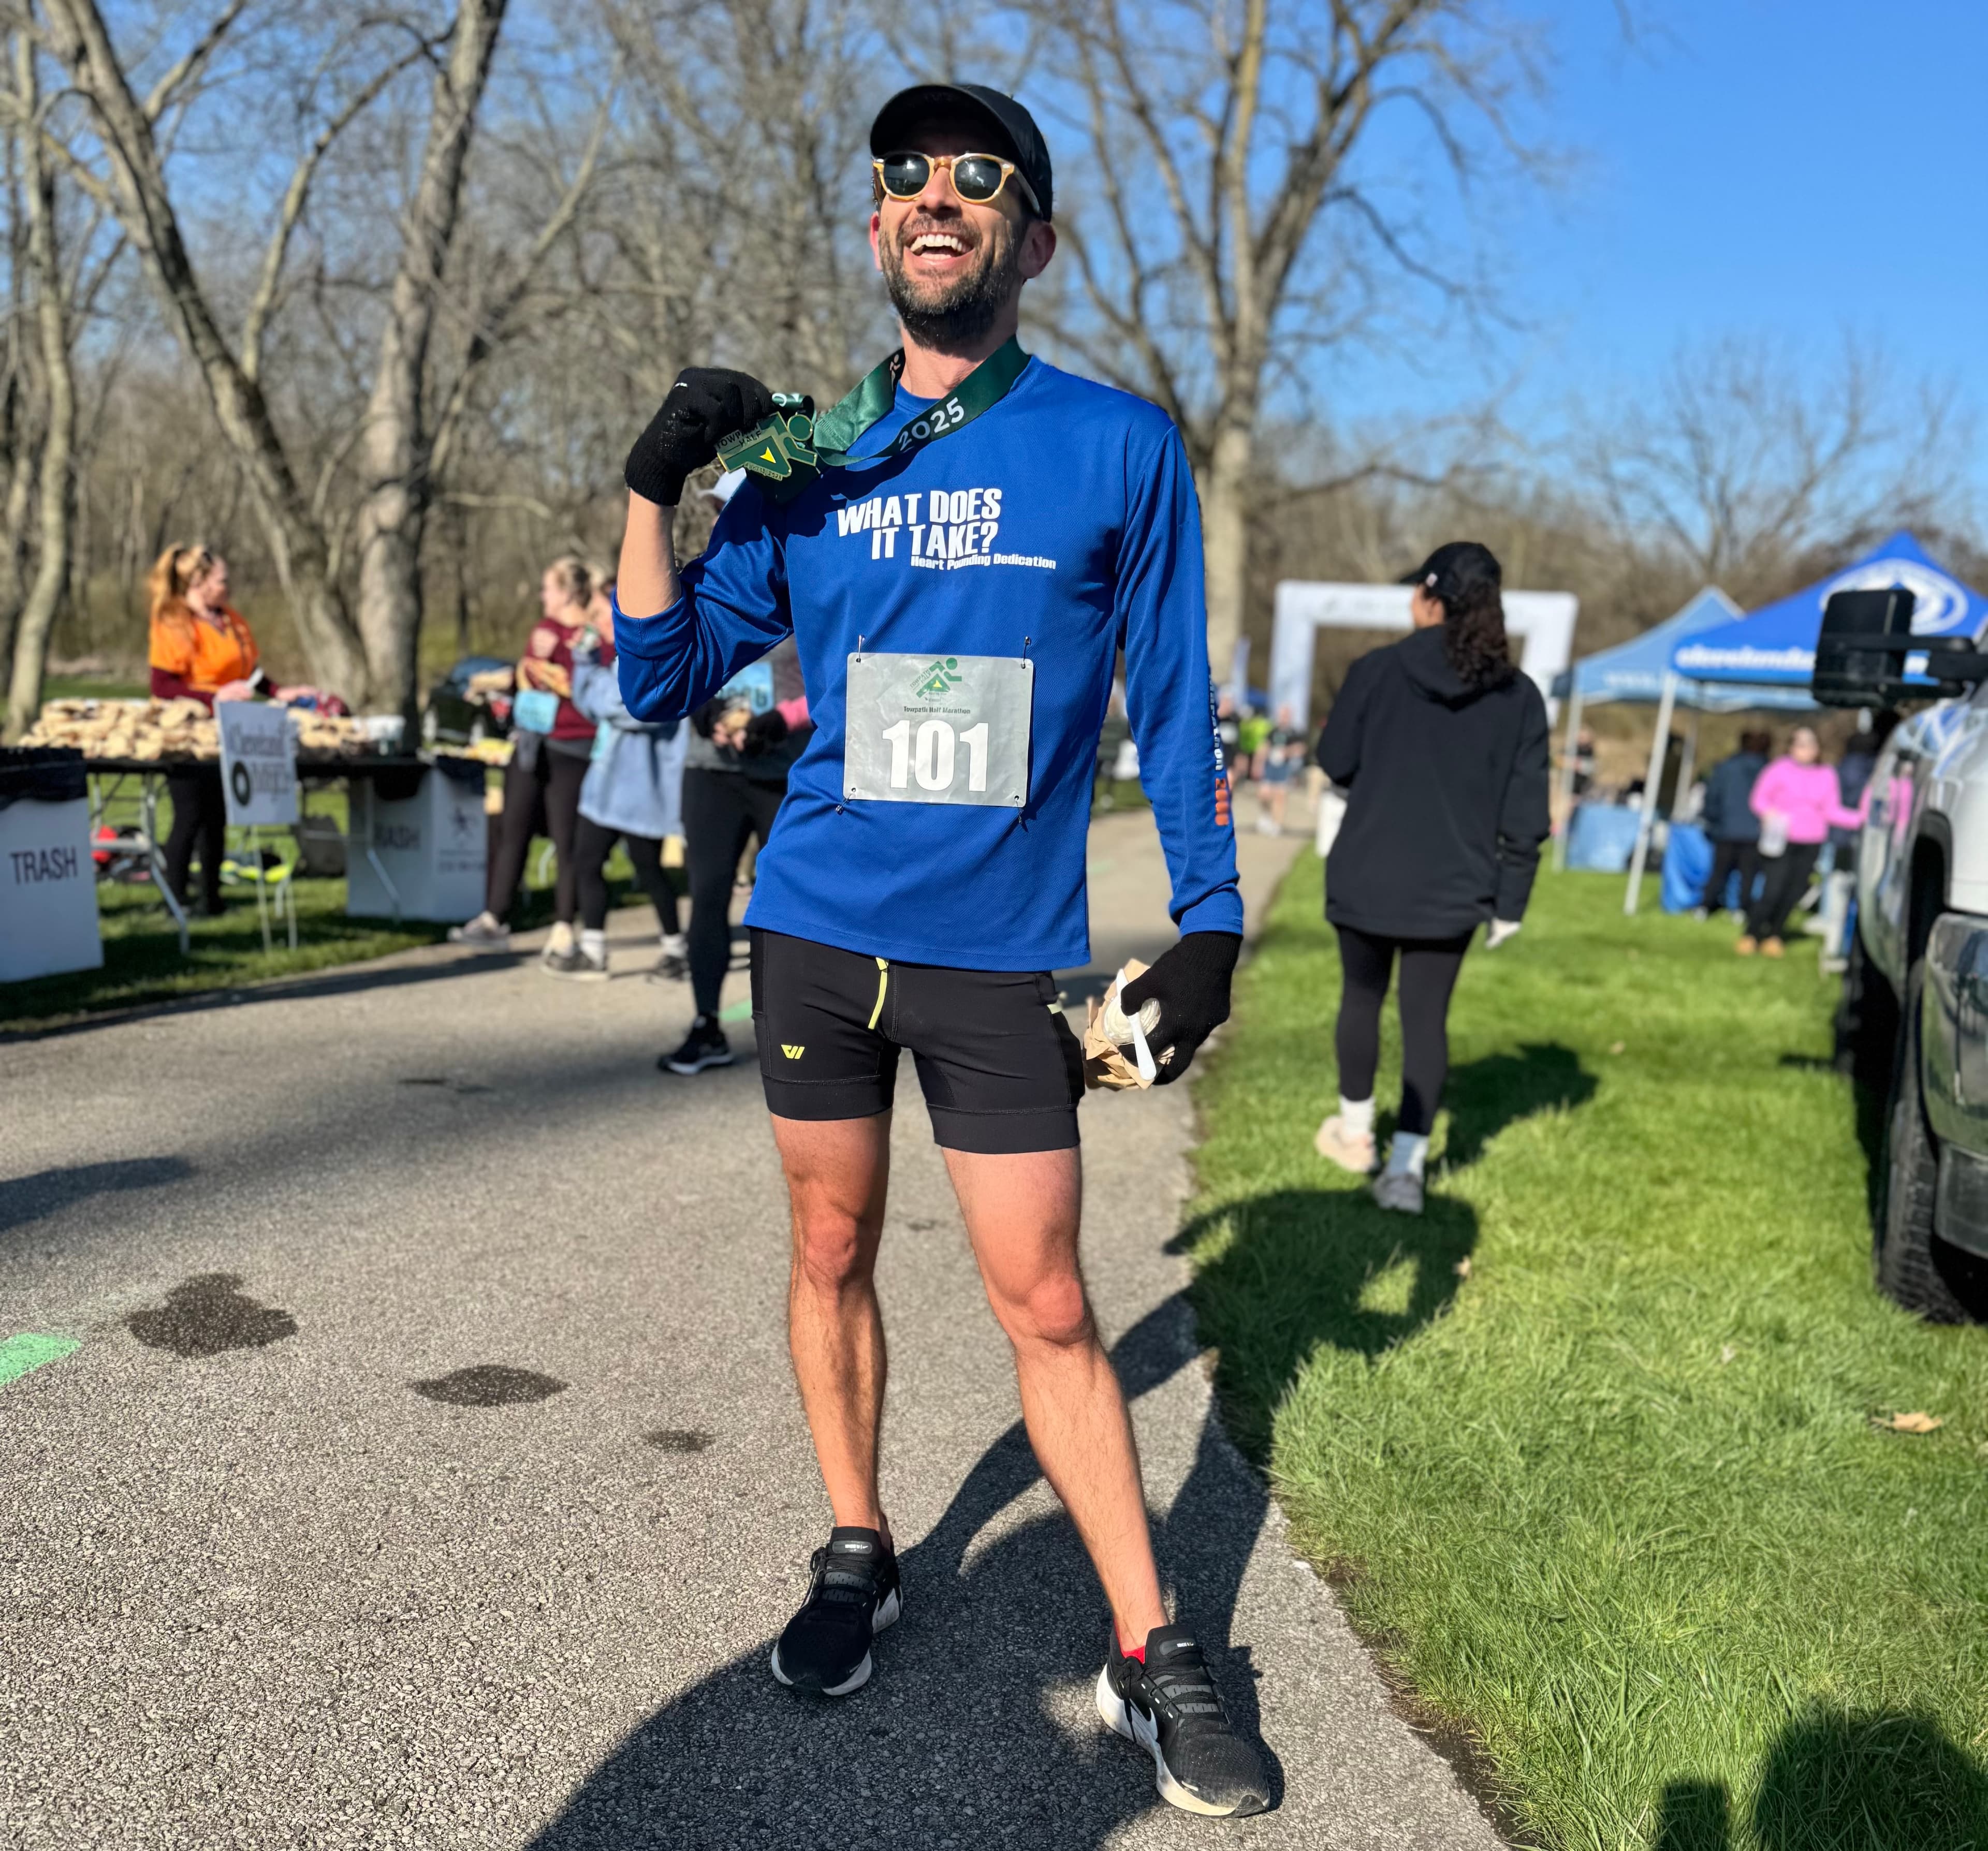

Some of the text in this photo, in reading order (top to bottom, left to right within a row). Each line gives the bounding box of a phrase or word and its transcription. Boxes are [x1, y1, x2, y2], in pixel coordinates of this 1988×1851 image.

[739, 430, 761, 447] HALF
[899, 397, 964, 451] 2025
[837, 488, 1002, 537] WHAT DOES
[871, 521, 999, 560] IT TAKE?
[911, 553, 1057, 570] Heart Pounding Dedication
[882, 719, 989, 792] 101
[9, 845, 78, 886] TRASH
